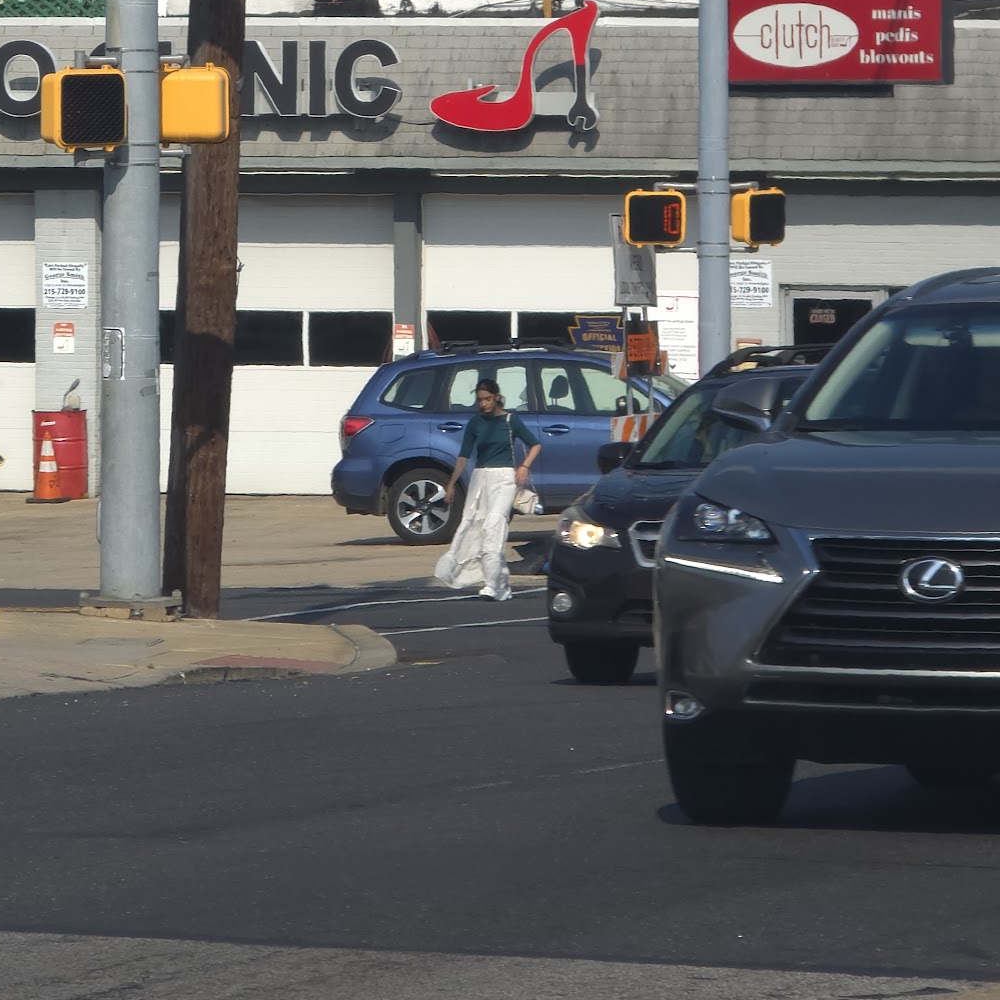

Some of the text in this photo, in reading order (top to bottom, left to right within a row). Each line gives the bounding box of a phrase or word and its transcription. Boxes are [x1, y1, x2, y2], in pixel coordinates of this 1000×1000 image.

[871, 6, 922, 20] manis
[760, 9, 831, 60] clutch
[875, 26, 919, 46] pedis
[859, 49, 935, 65] blowouts
[582, 332, 617, 341] OFFICIAL
